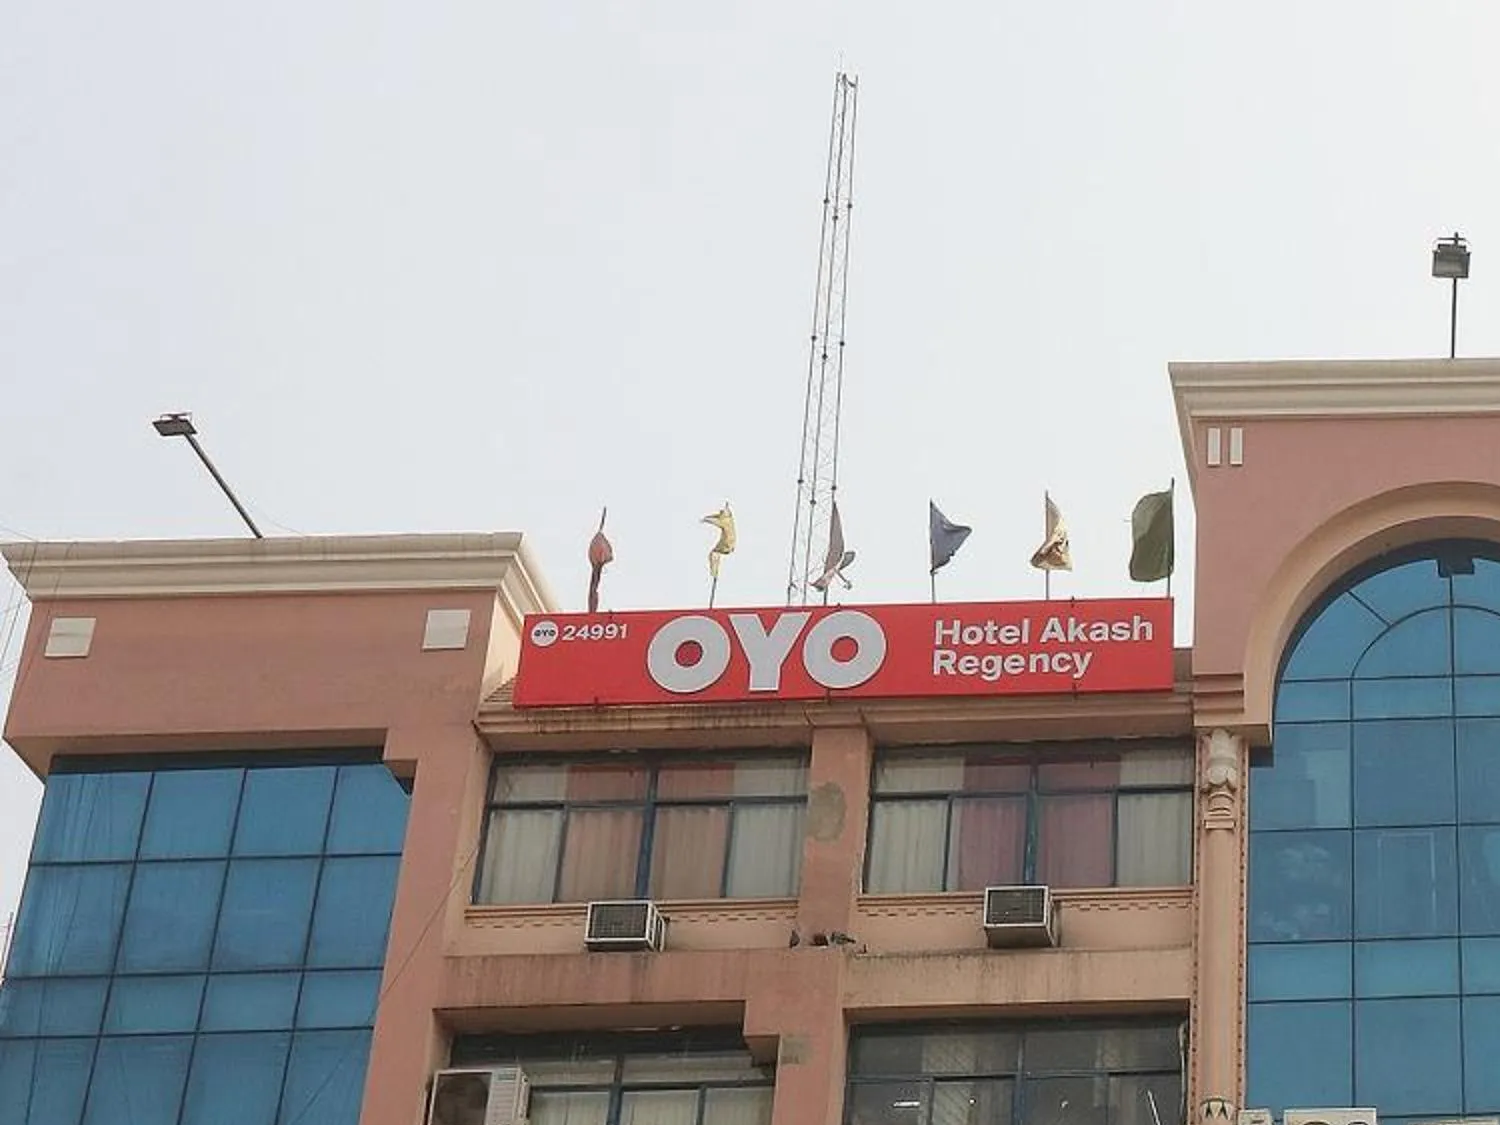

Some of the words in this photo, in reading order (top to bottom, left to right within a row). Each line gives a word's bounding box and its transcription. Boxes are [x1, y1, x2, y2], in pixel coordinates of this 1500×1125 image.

[562, 623, 629, 641] 24991
[934, 617, 1034, 647] Hotel
[1040, 614, 1153, 644] Akash
[647, 610, 887, 693] OYO
[932, 646, 1093, 681] Regency
